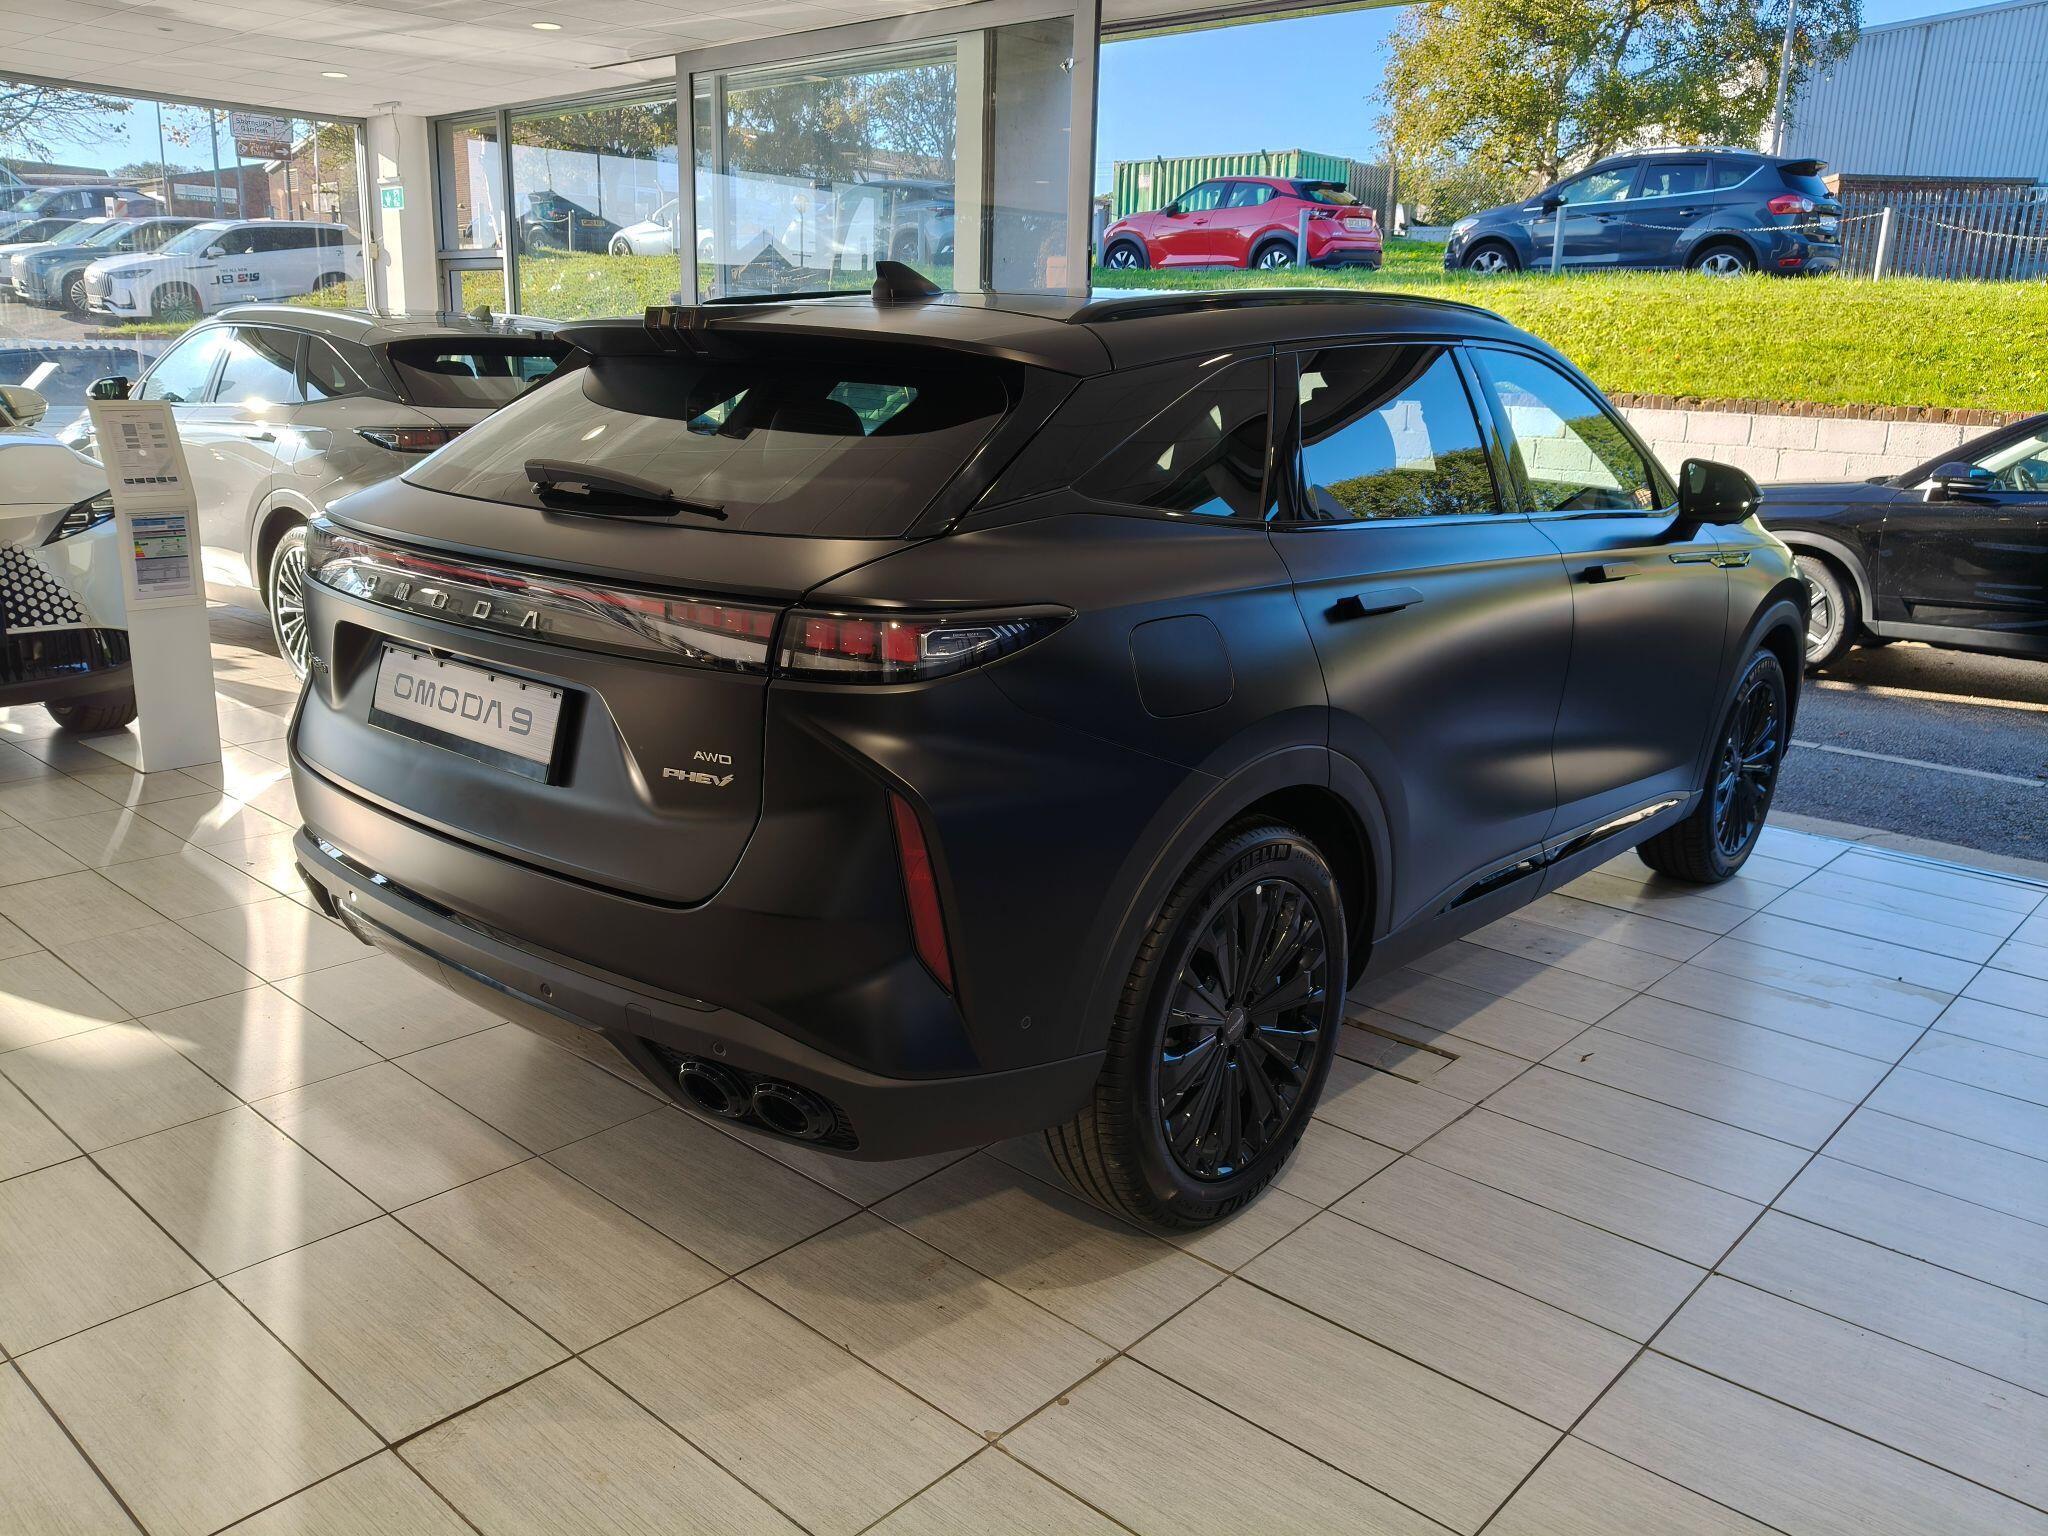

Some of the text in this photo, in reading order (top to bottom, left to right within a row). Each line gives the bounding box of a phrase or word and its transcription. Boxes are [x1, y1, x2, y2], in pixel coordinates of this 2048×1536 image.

[366, 575, 538, 630] OMODA
[693, 750, 732, 765] AWD
[662, 767, 735, 787] PHEV
